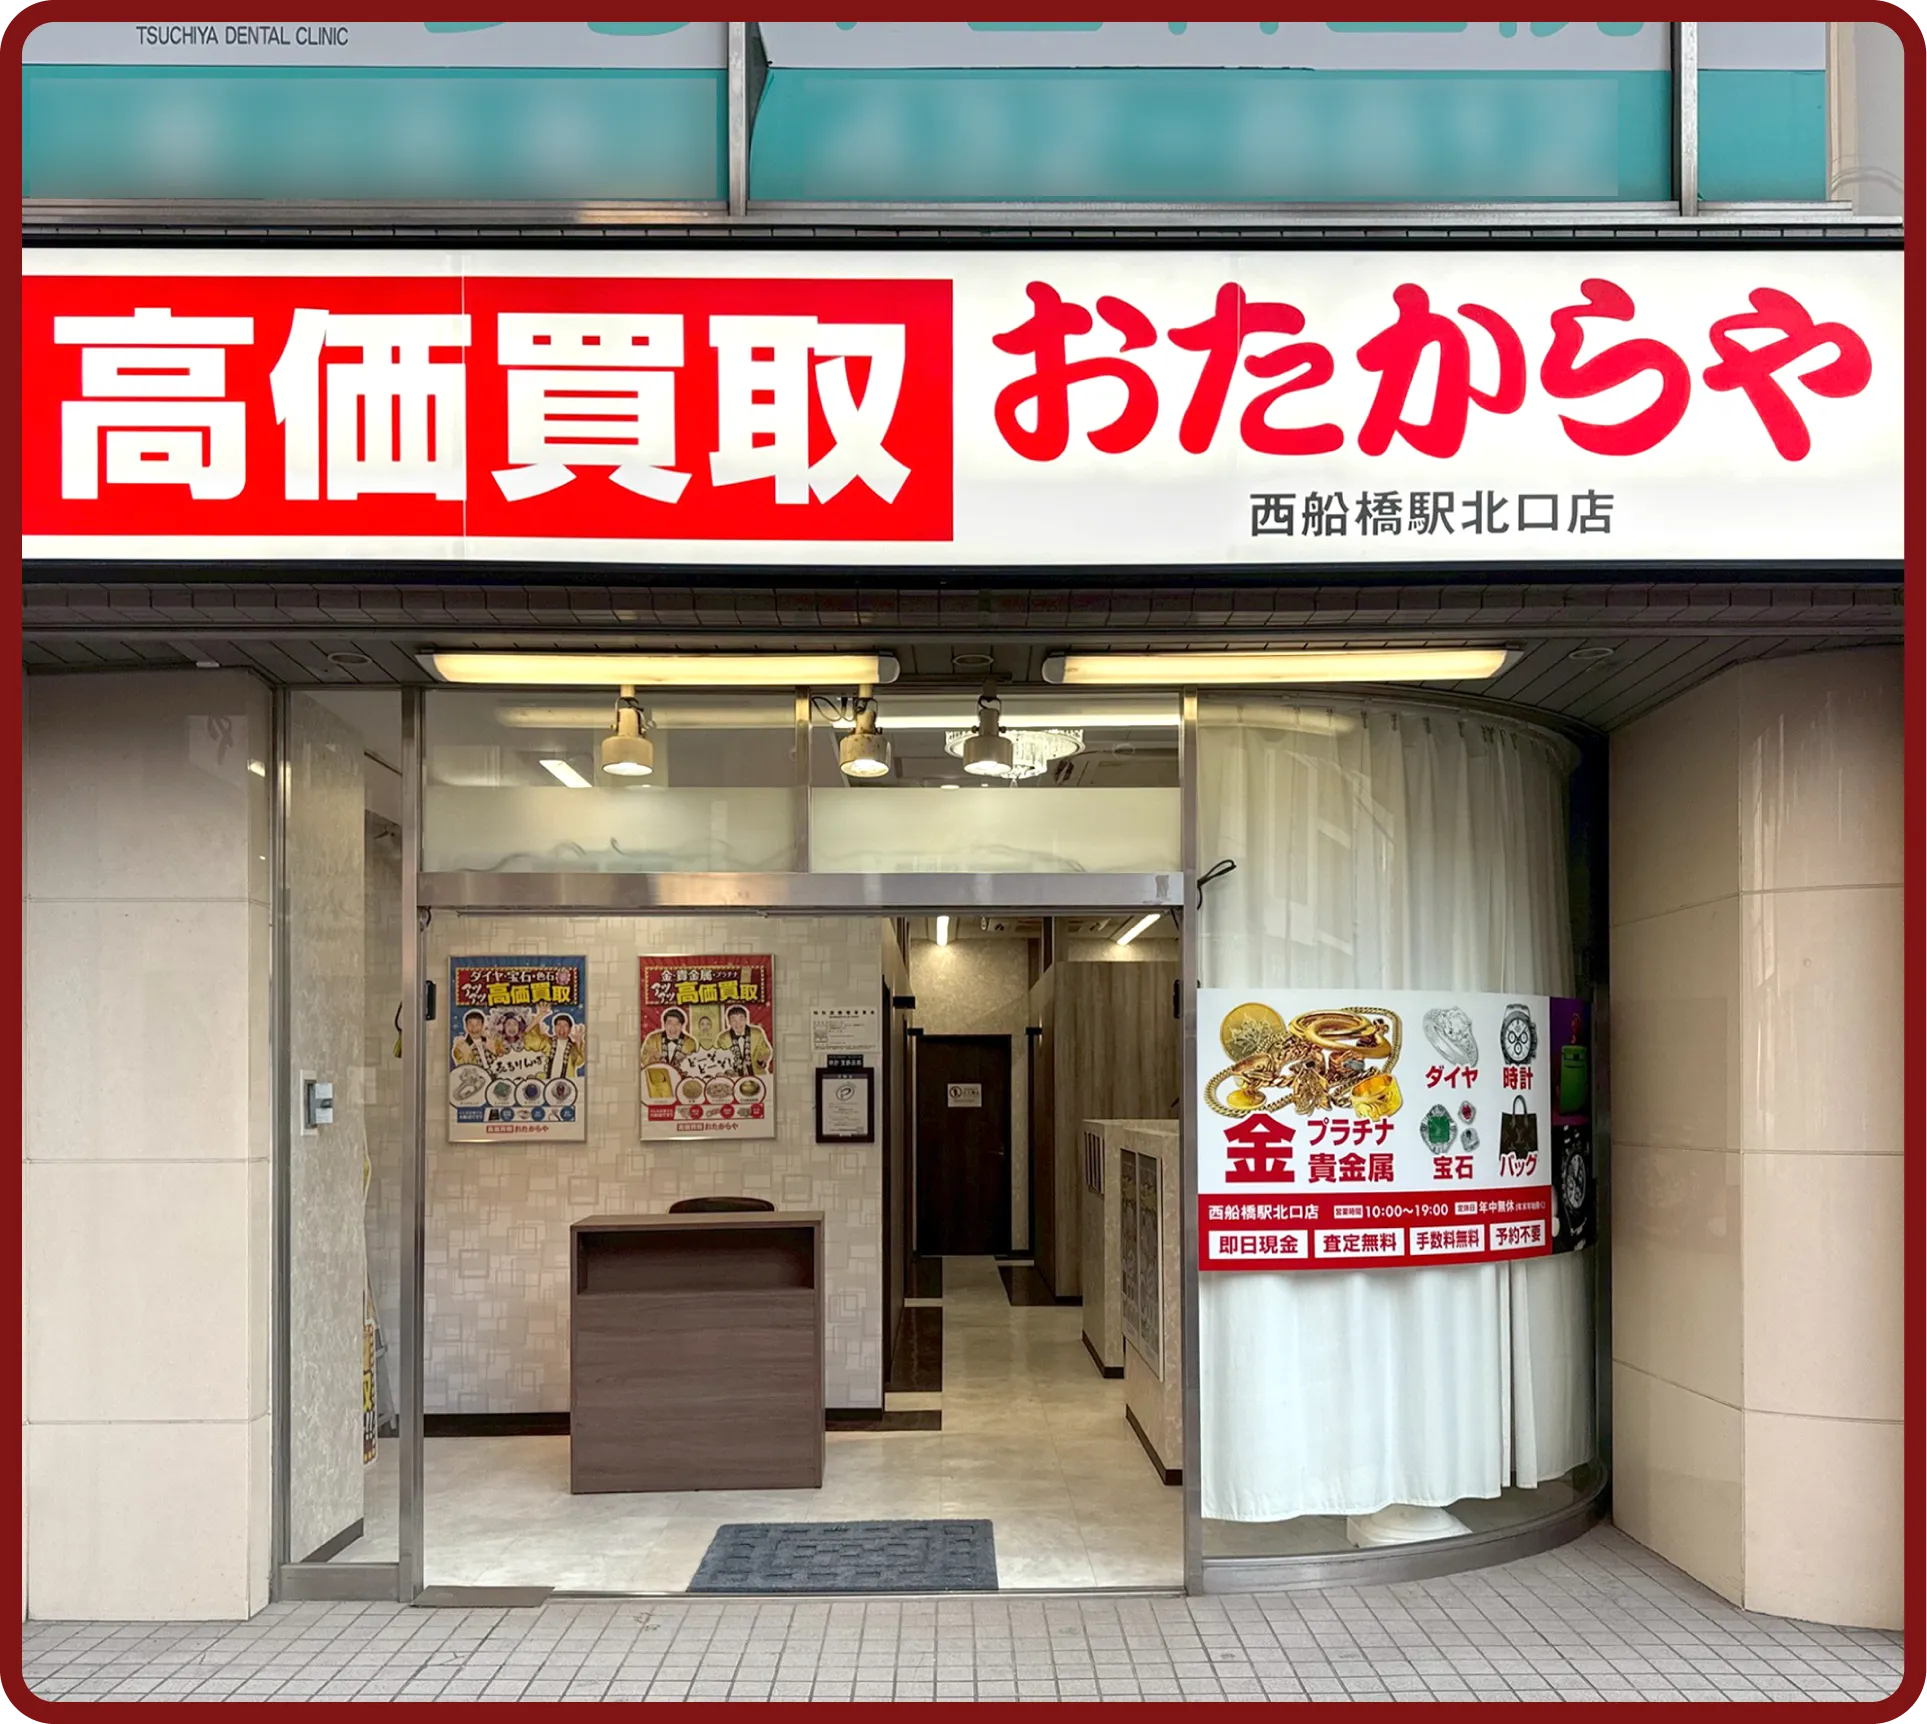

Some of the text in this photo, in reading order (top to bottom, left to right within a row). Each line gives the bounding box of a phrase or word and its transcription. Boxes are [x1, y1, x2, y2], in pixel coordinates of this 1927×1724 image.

[136, 26, 349, 46] TSUCHIYA DENTAL CLINIC
[992, 278, 1872, 462] おたからや
[54, 307, 911, 504] 高価買取
[1250, 490, 1614, 537] 西船橋駅北口店
[486, 981, 571, 1006] 高価買取
[675, 980, 758, 1005] 高価買取
[1425, 1065, 1479, 1089] ダイヤ
[1502, 1066, 1534, 1090] 時計
[1307, 1117, 1395, 1146] プラチナ
[1224, 1113, 1296, 1183] 金
[1308, 1152, 1394, 1183] 貴金属
[1433, 1155, 1474, 1180] 宝石
[1500, 1152, 1538, 1177] バッグ
[1208, 1204, 1319, 1221] 西船橋駅北口店
[1366, 1203, 1449, 1219] 10:00～19:00
[1479, 1200, 1515, 1214] 年中無休
[1219, 1235, 1299, 1255] 即日現金
[1323, 1232, 1397, 1253] 査定無料
[1416, 1229, 1480, 1250] 手数料無料
[1496, 1224, 1541, 1246] 予約不要
